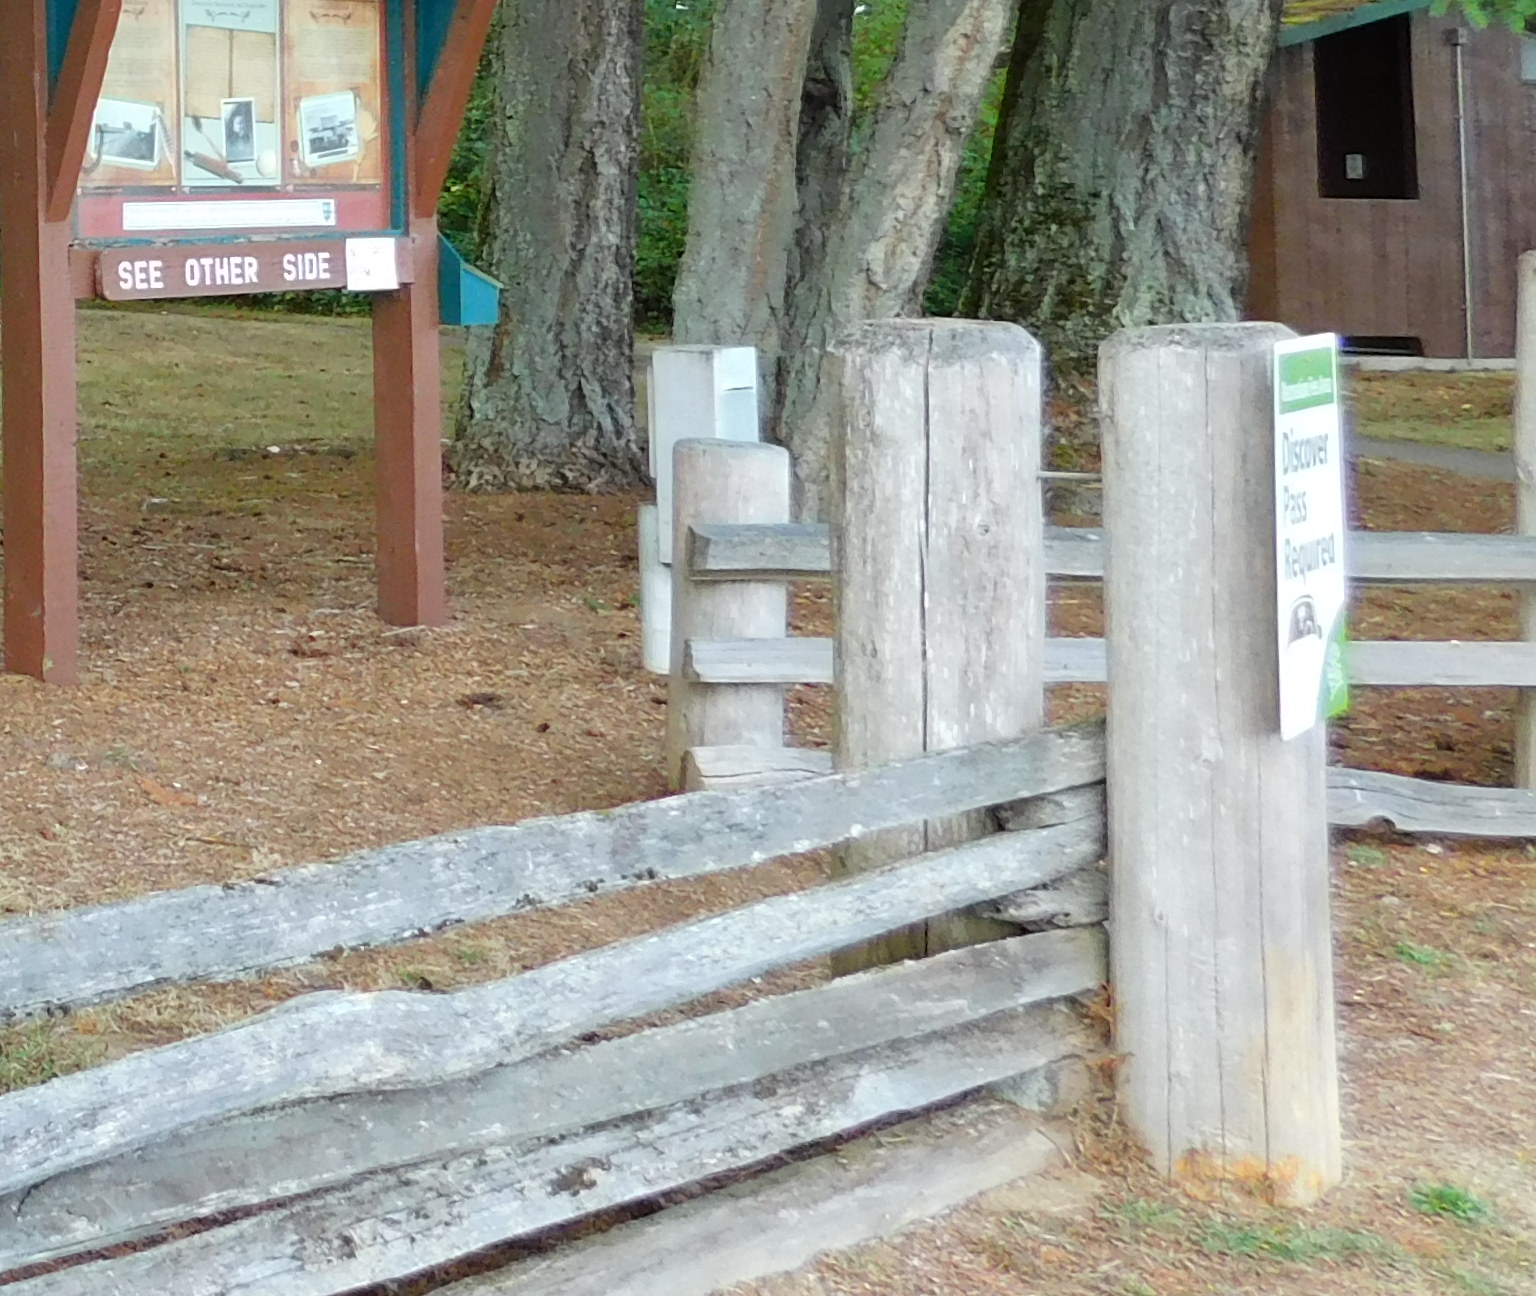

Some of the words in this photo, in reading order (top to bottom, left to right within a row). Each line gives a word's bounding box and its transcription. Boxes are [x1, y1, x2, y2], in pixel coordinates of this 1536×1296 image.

[118, 260, 164, 290] SEE
[185, 257, 258, 286] OTHER
[283, 252, 331, 281] SIDE
[1282, 429, 1328, 475] Discover
[1283, 485, 1307, 527] Pass
[1285, 533, 1335, 584] Required
